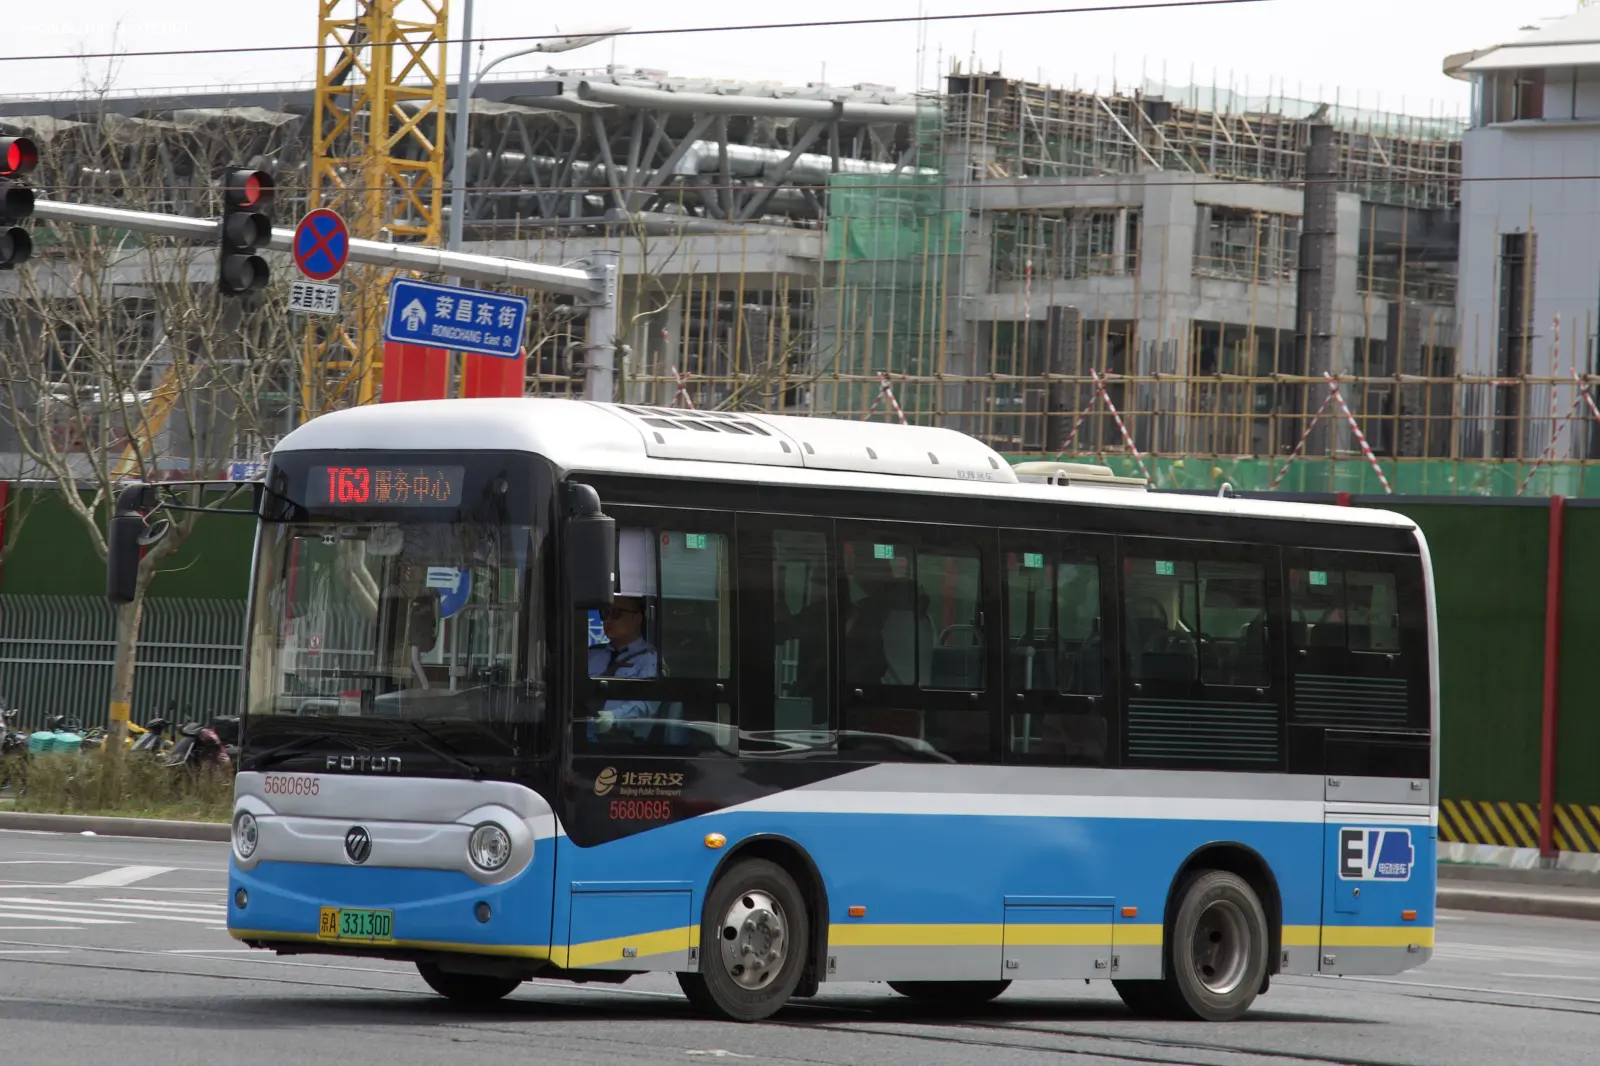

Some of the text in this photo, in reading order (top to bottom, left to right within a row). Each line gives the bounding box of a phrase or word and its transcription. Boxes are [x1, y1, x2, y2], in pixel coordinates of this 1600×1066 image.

[292, 284, 336, 310] 荣昌东街
[434, 295, 517, 330] 荣昌东街
[431, 324, 513, 348] RONGCHANG East St
[326, 467, 451, 504] T63 服务中心
[326, 755, 402, 773] FOTON
[264, 775, 320, 796] 5680695
[621, 772, 684, 786] 北京公交
[620, 788, 682, 797] Beijing Public Transport
[609, 800, 671, 820] 5680695
[1341, 829, 1386, 878] EV
